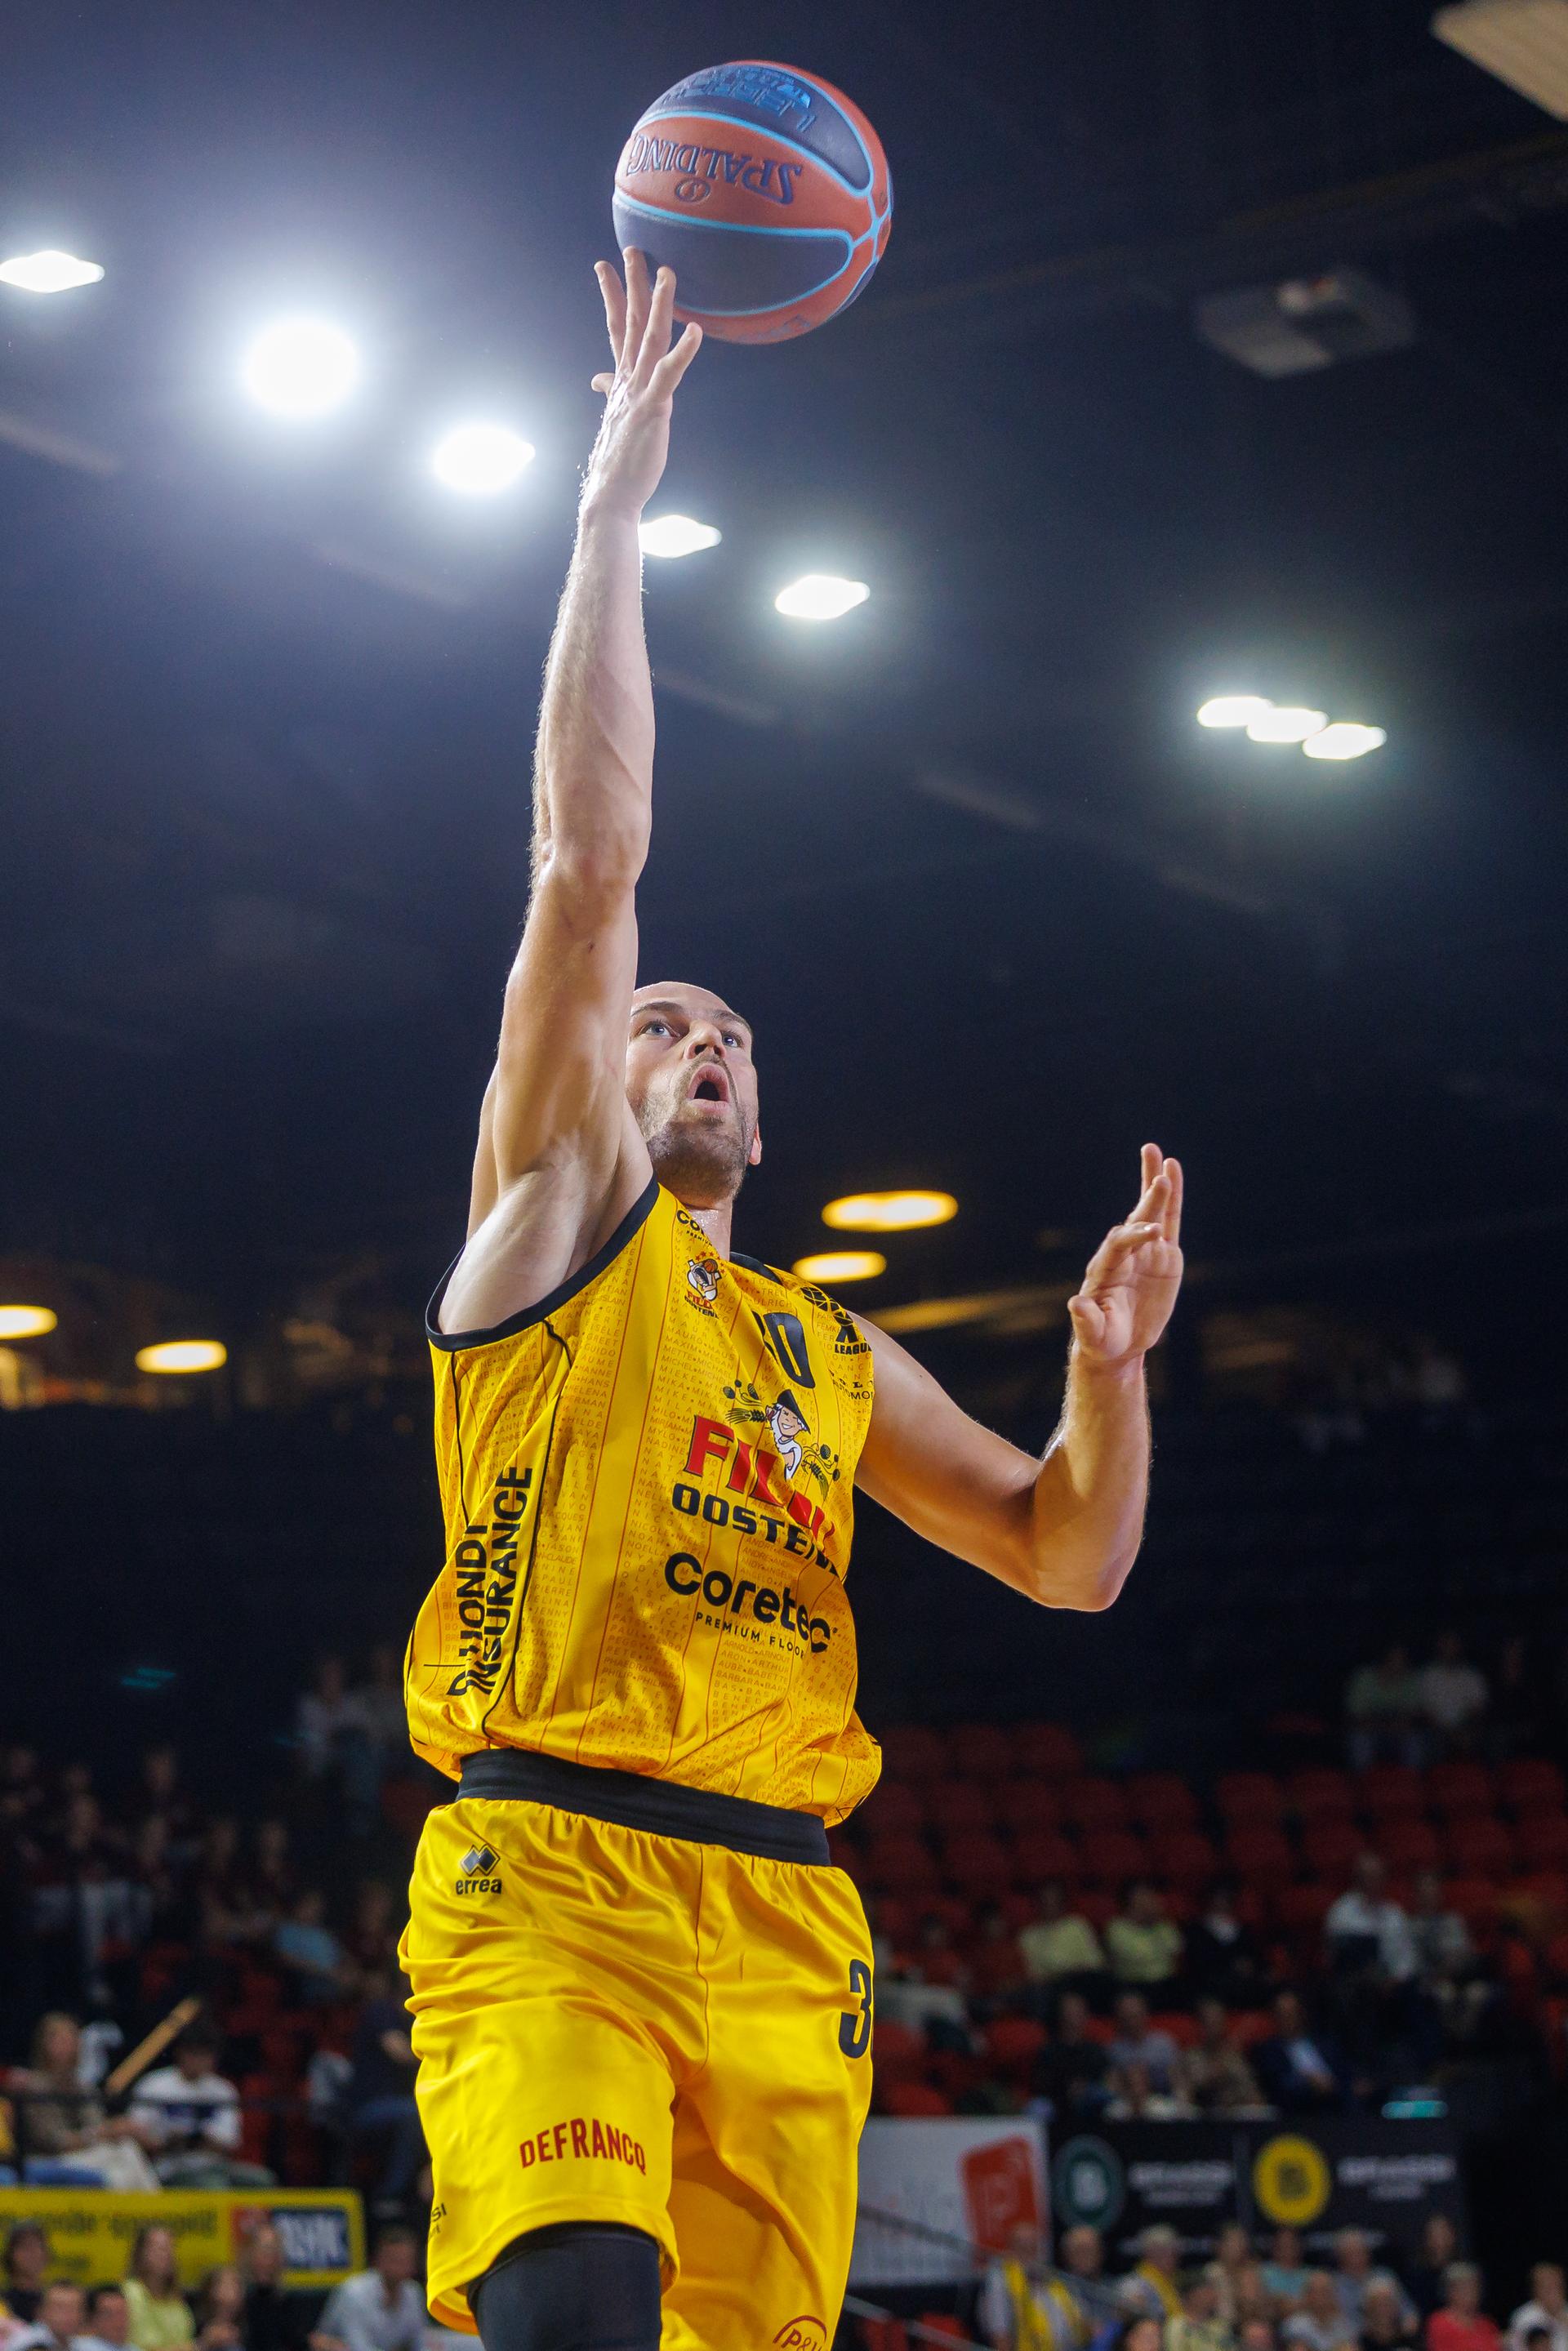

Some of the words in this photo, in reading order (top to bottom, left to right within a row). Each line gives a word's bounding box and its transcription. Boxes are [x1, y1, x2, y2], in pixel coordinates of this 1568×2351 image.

[626, 133, 802, 205] SPALDING
[664, 1552, 831, 1653] Coretec
[696, 1611, 760, 1642] PREMIUM
[455, 1877, 502, 1895] errea
[519, 2117, 647, 2176] DEFRANCQ
